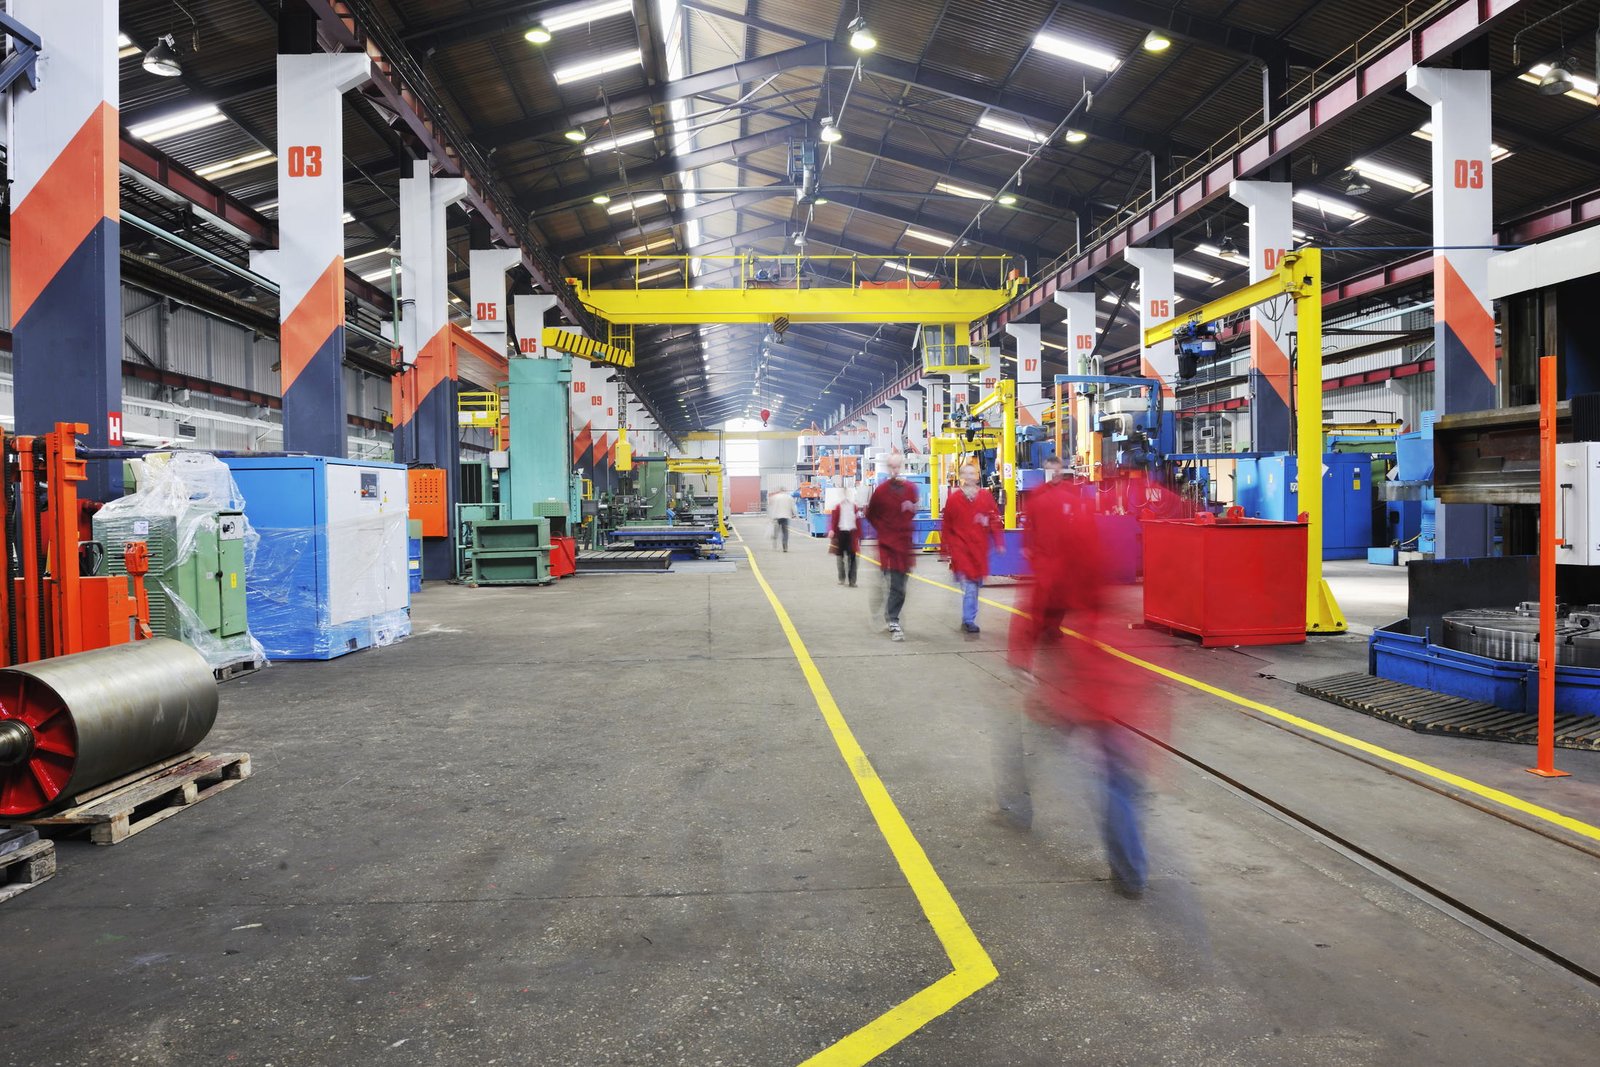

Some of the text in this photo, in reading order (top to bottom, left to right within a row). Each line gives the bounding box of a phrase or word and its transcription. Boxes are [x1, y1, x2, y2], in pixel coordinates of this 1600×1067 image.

[288, 146, 322, 176] 03
[1455, 160, 1483, 189] 03
[477, 303, 496, 320] 05
[1151, 300, 1169, 317] 05
[520, 338, 536, 353] 06
[1076, 335, 1092, 349] 06
[1025, 359, 1037, 371] 07
[574, 382, 586, 392] 08
[591, 396, 602, 406] 09
[956, 393, 966, 403] 09
[109, 417, 121, 441] H
